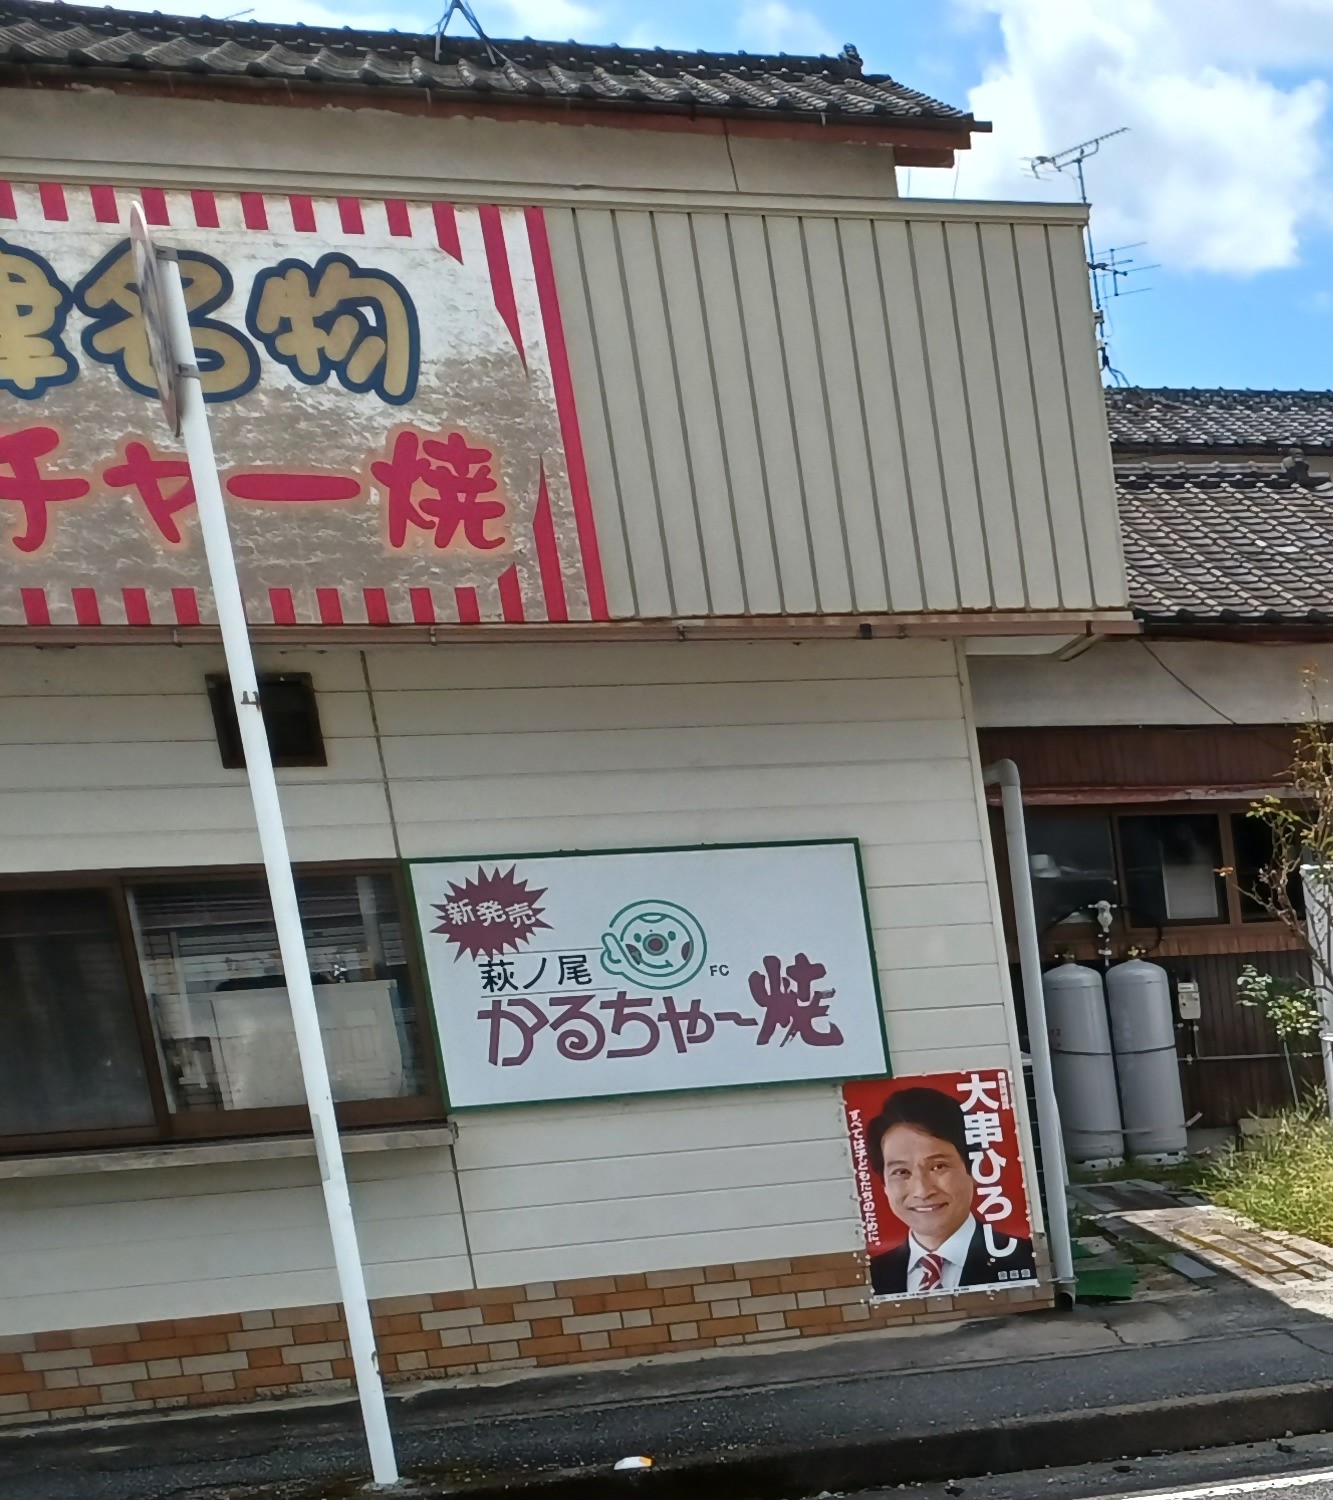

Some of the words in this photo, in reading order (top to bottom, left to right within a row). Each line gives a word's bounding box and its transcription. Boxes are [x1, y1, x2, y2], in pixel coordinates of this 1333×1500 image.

[446, 898, 537, 929] 新発売
[478, 954, 594, 994] 萩ノ尾
[710, 963, 730, 978] FC
[957, 1074, 1018, 1257] 大串ひろし
